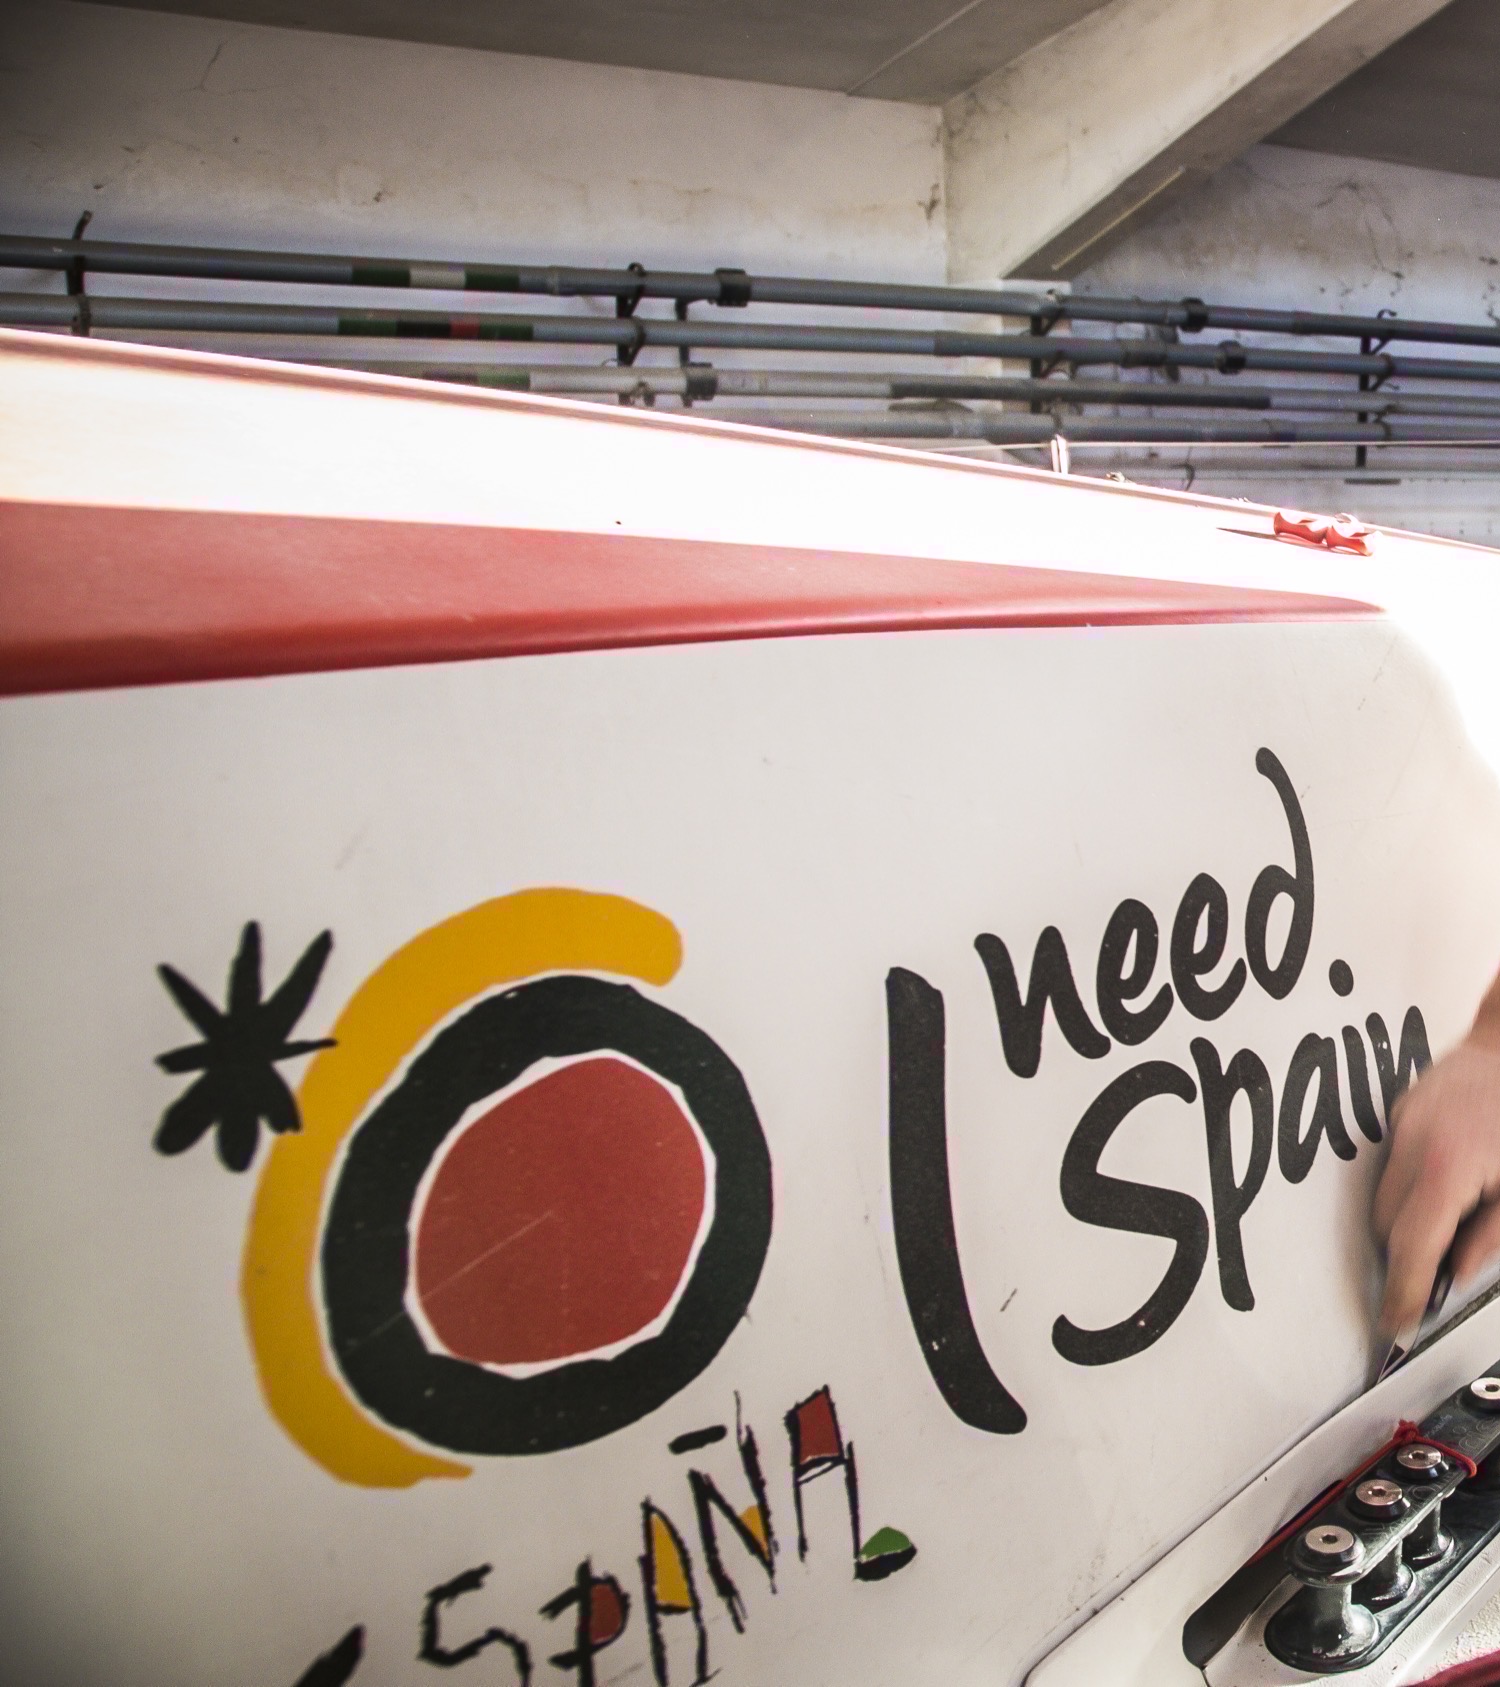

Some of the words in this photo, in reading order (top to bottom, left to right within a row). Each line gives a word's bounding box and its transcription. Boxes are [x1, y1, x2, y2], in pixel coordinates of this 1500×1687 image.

[886, 966, 1027, 1434] I
[974, 747, 1314, 1078] need
[292, 1384, 917, 1687] SPAÑA
